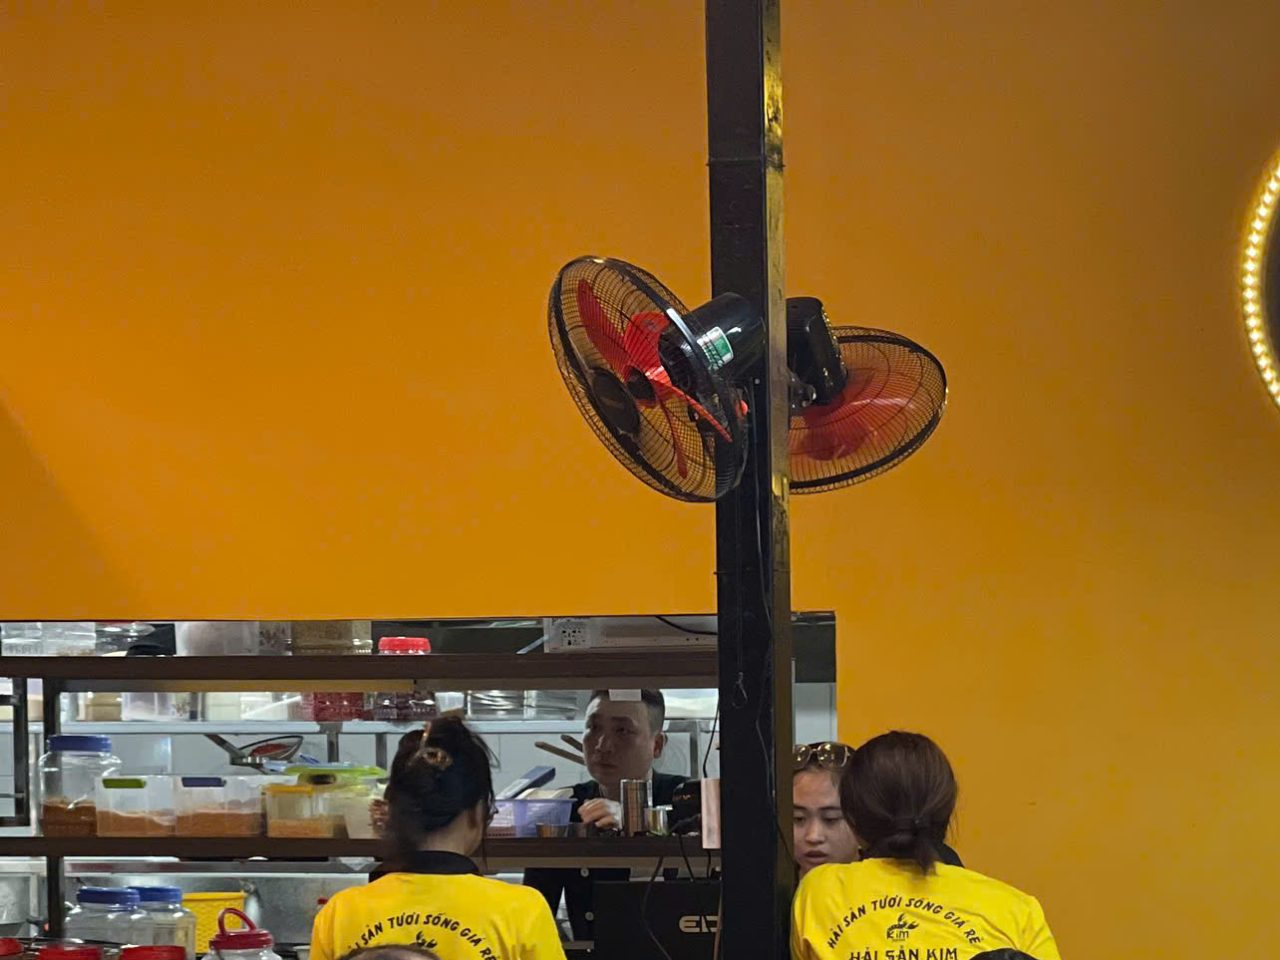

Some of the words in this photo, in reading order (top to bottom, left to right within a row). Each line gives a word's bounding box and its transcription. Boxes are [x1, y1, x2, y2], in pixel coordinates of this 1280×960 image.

[843, 905, 866, 927] SẢN
[944, 911, 969, 928] GIÁ
[361, 922, 383, 945] SẢN
[460, 928, 485, 947] GIÁ
[926, 948, 958, 960] KIM
